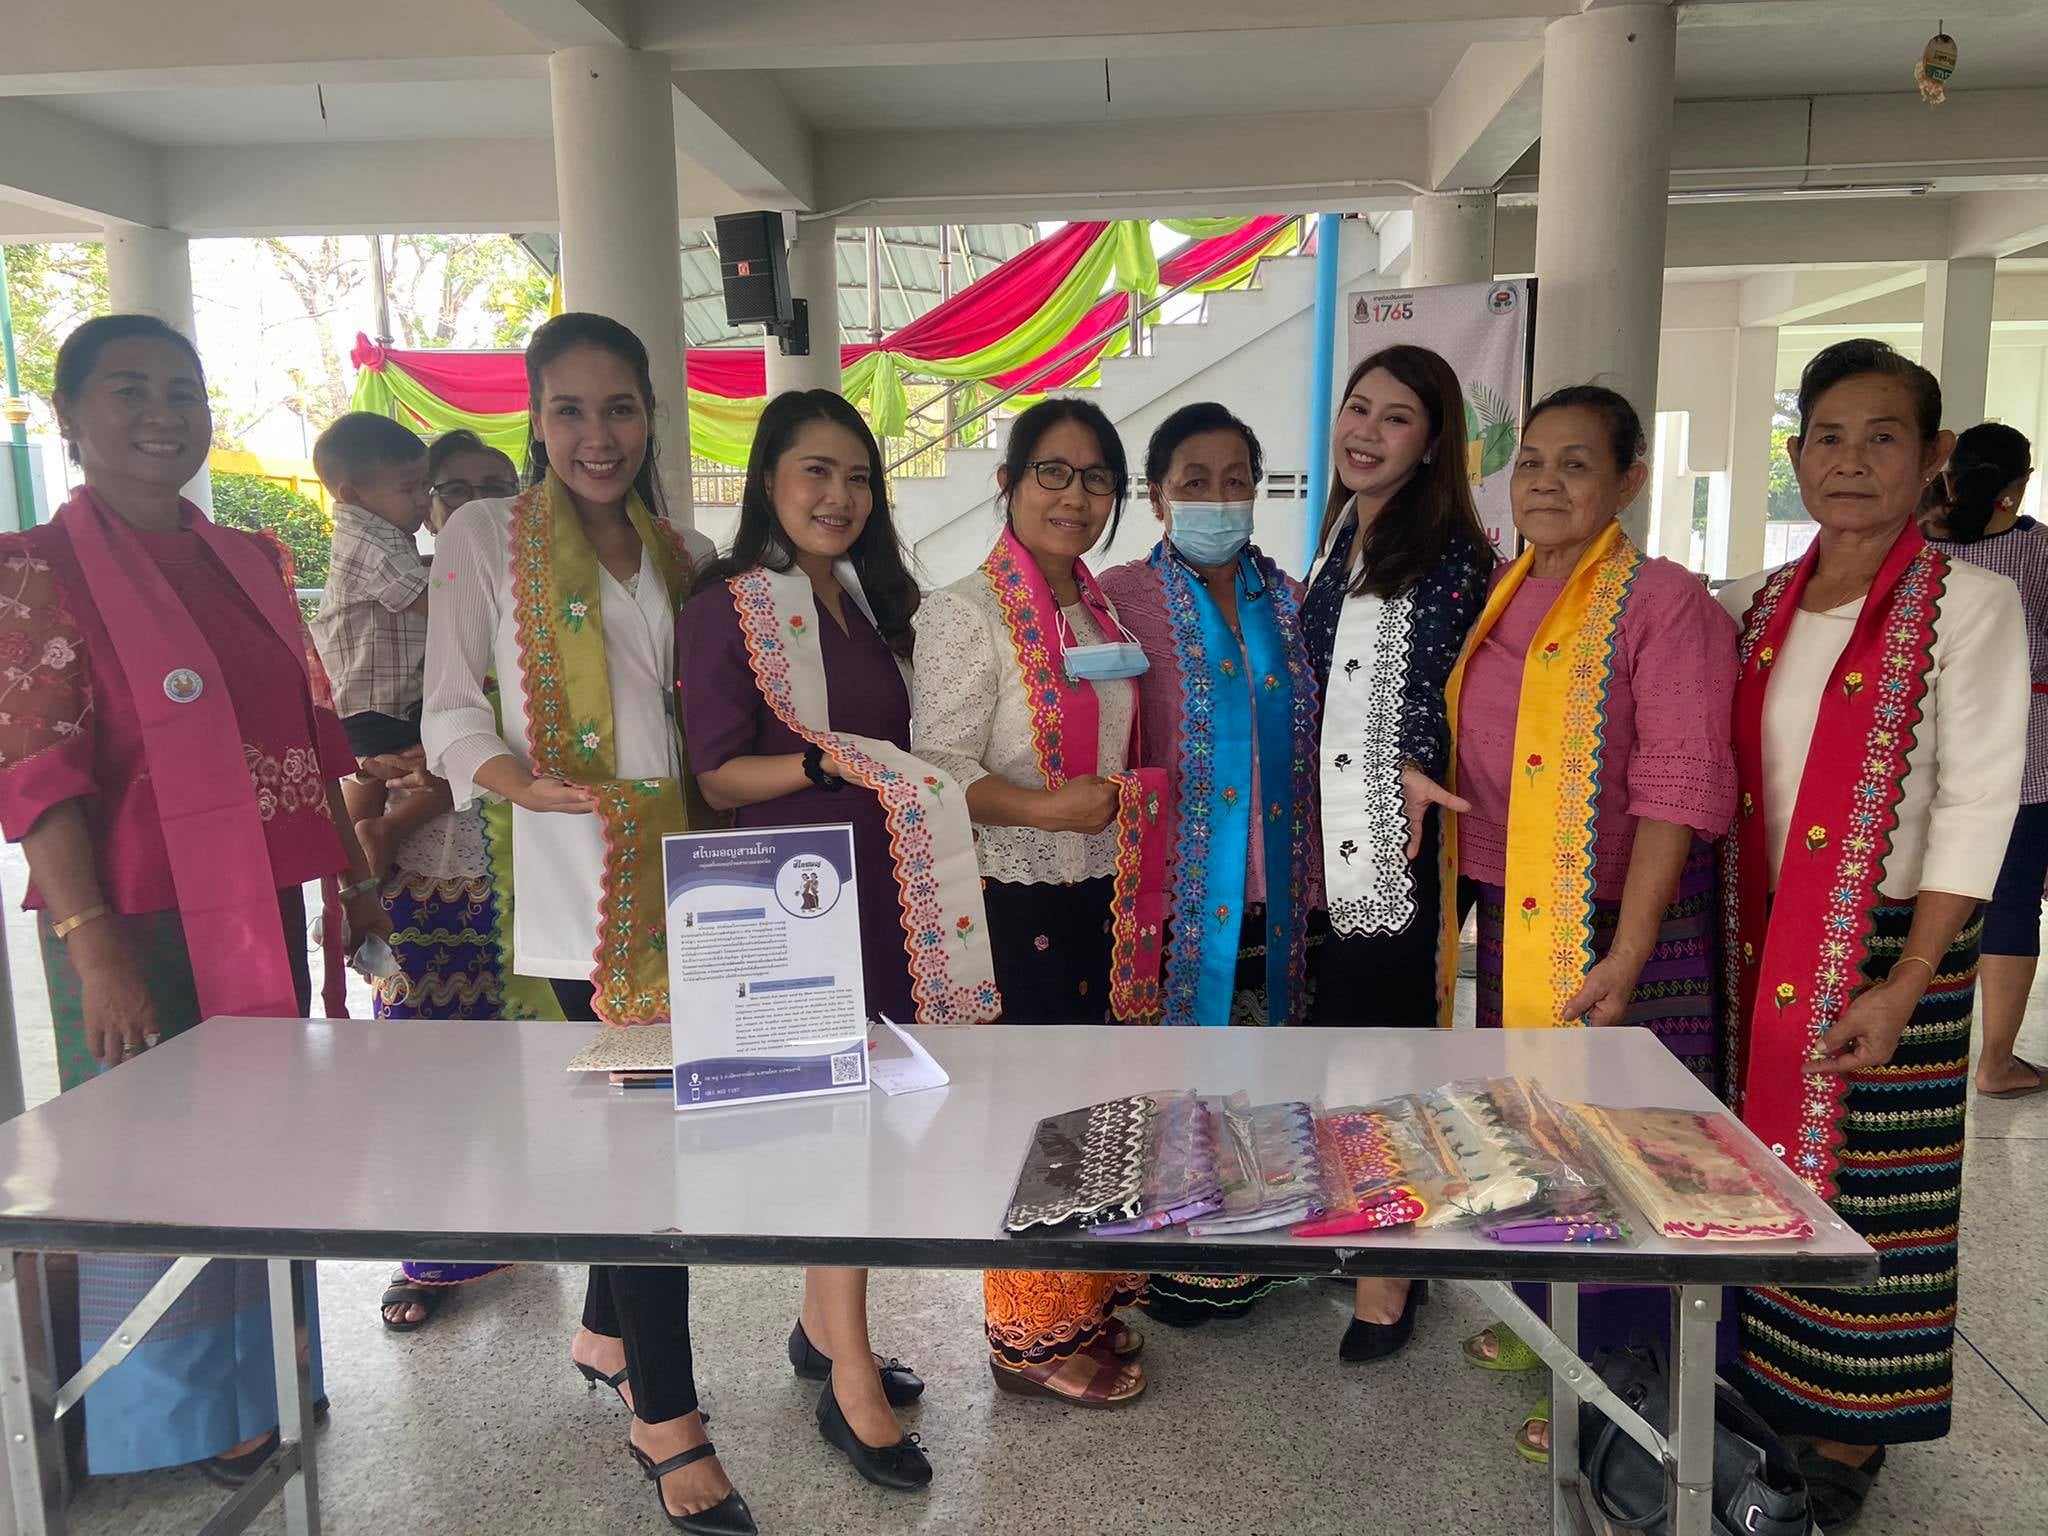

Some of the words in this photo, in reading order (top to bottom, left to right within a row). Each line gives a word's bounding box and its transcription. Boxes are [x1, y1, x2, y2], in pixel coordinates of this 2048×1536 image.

[1373, 302, 1414, 322] 1765
[692, 842, 776, 859] สไบมอญสามโคก
